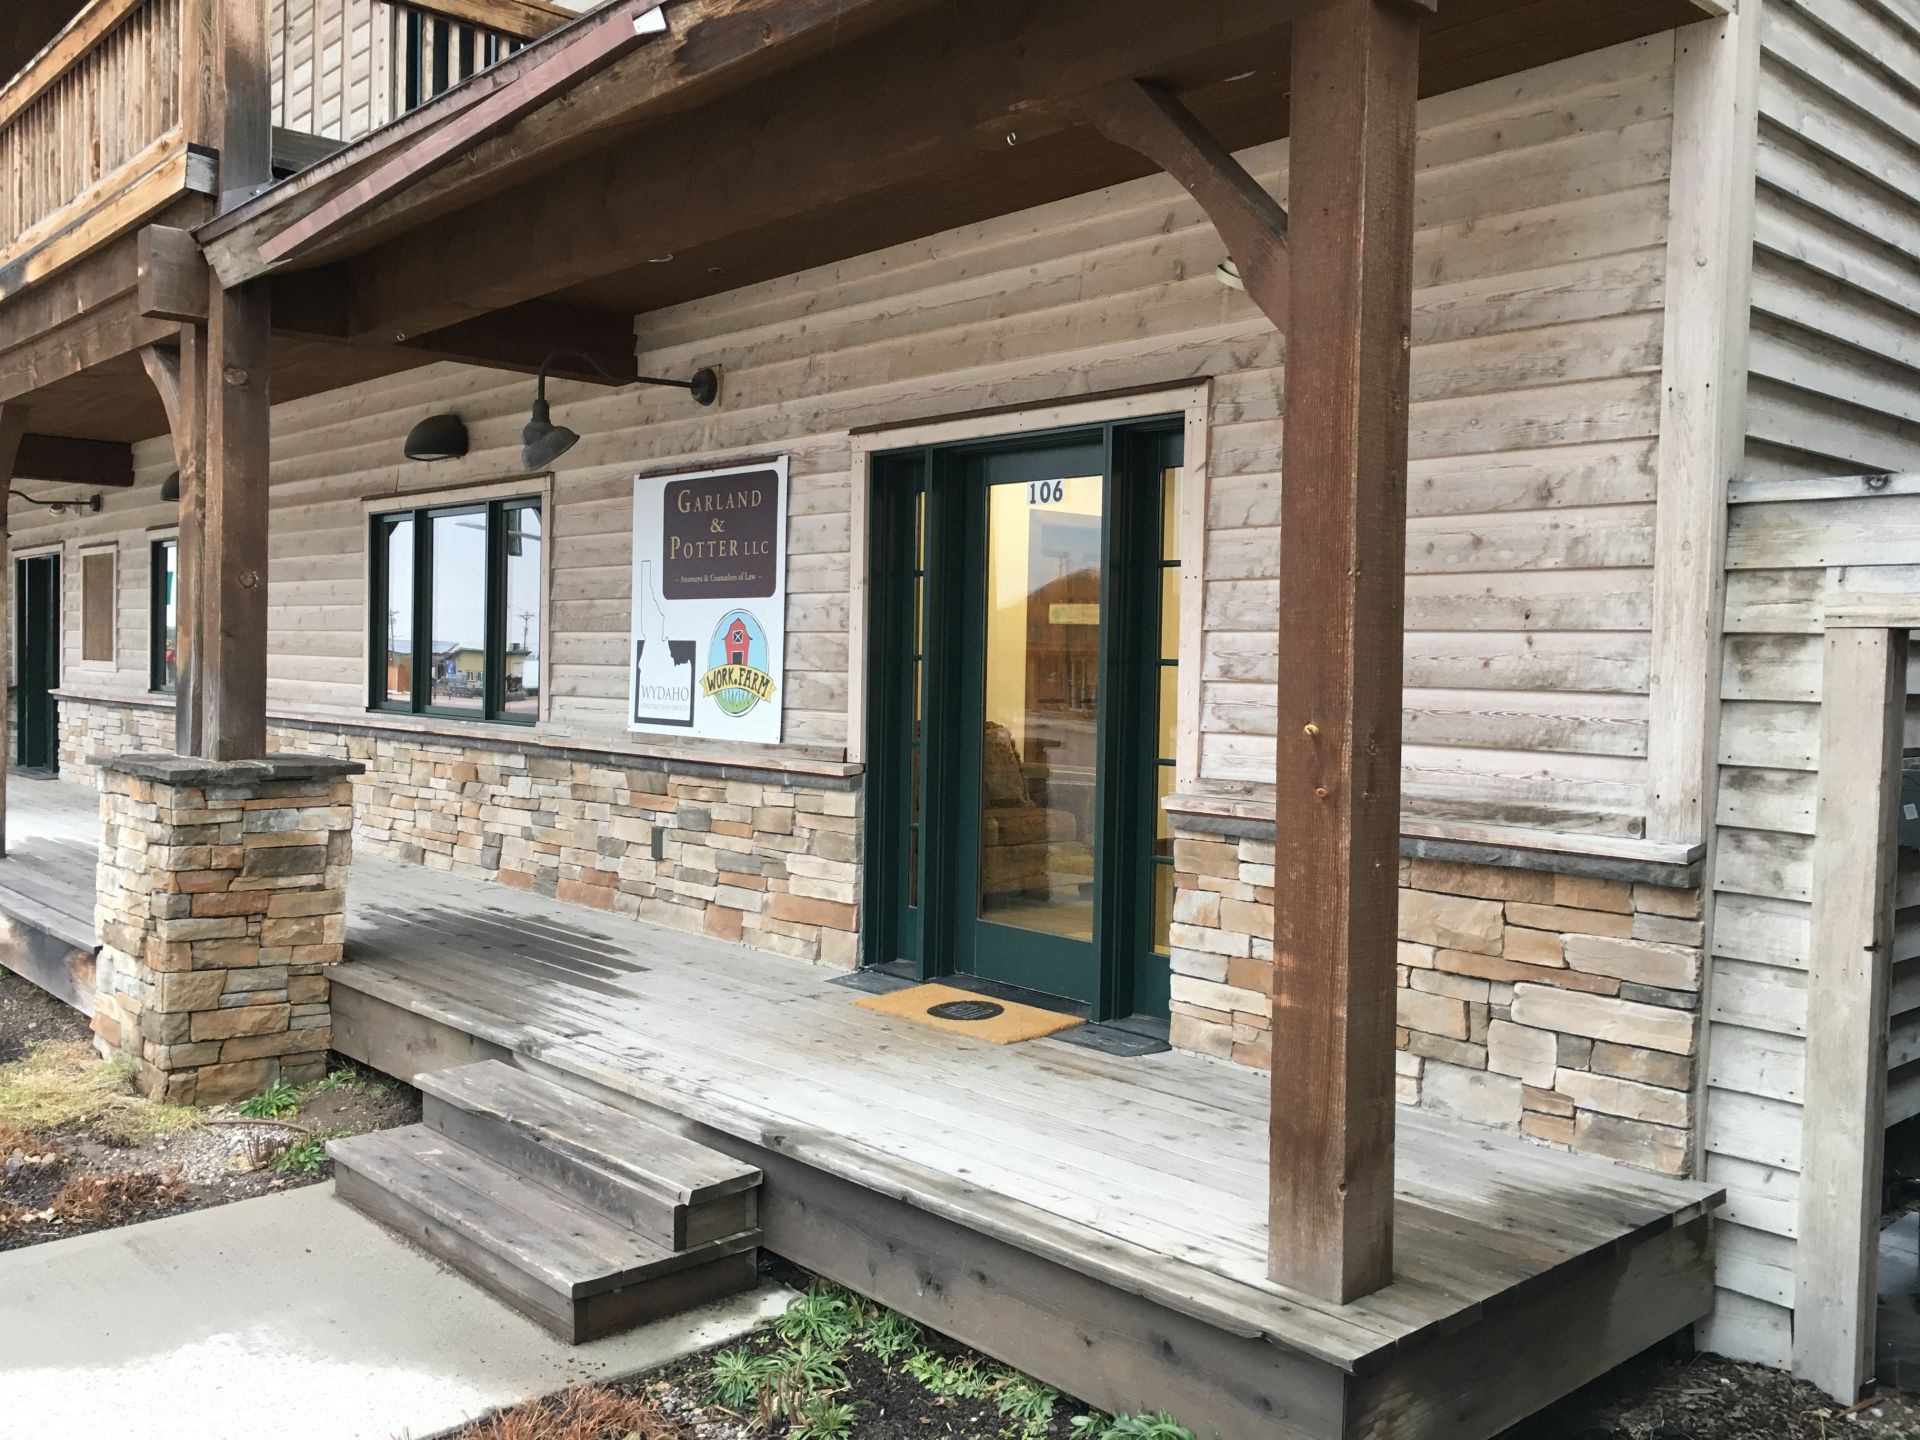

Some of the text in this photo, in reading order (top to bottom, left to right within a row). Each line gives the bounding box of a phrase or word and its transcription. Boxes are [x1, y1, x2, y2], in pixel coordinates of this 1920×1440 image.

[677, 490, 762, 513] GARLAND
[1030, 481, 1063, 503] 106
[710, 518, 726, 533] &
[670, 536, 768, 560] POTTER LLC
[704, 574, 709, 582] &
[745, 571, 756, 581] Law
[641, 685, 689, 701] WYDAHO
